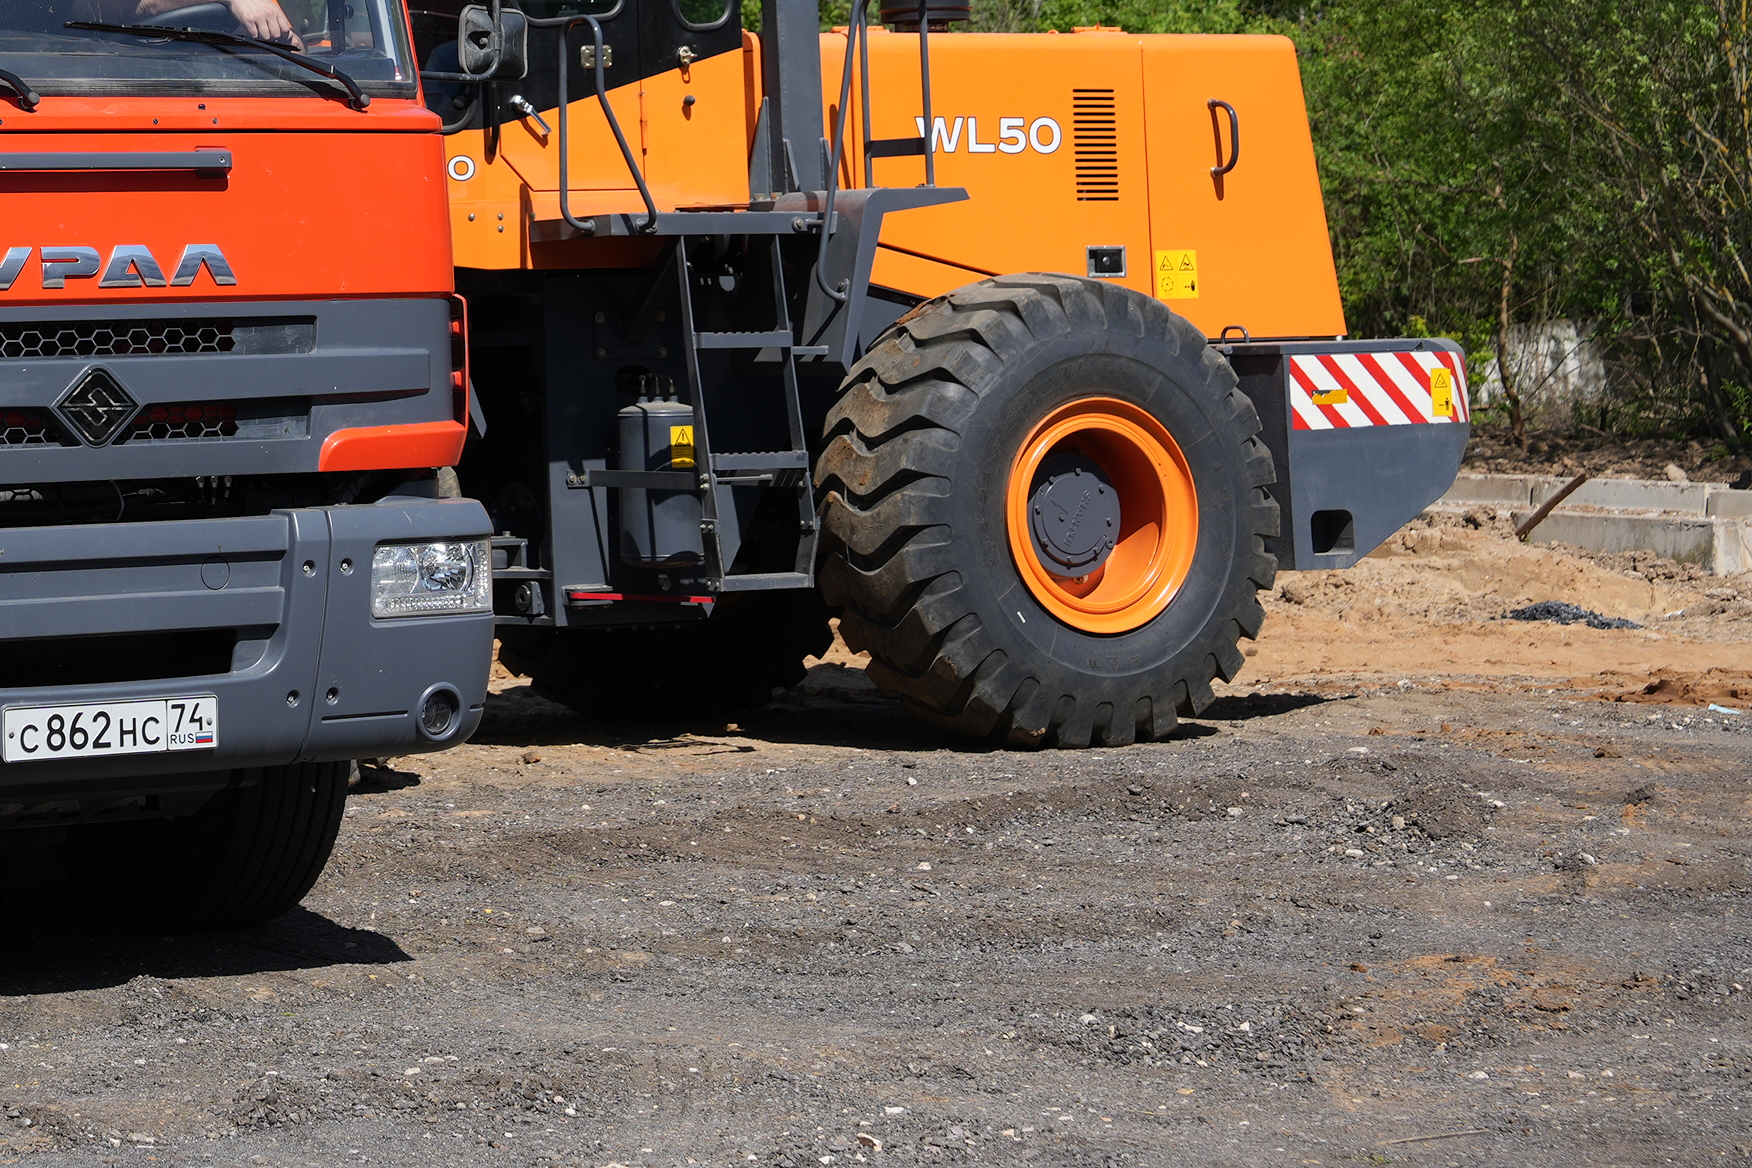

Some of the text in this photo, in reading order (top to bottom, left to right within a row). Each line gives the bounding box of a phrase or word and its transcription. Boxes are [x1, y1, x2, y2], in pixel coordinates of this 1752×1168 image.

[914, 116, 1063, 154] WL50
[171, 702, 203, 732] 74
[170, 733, 195, 744] RUS
